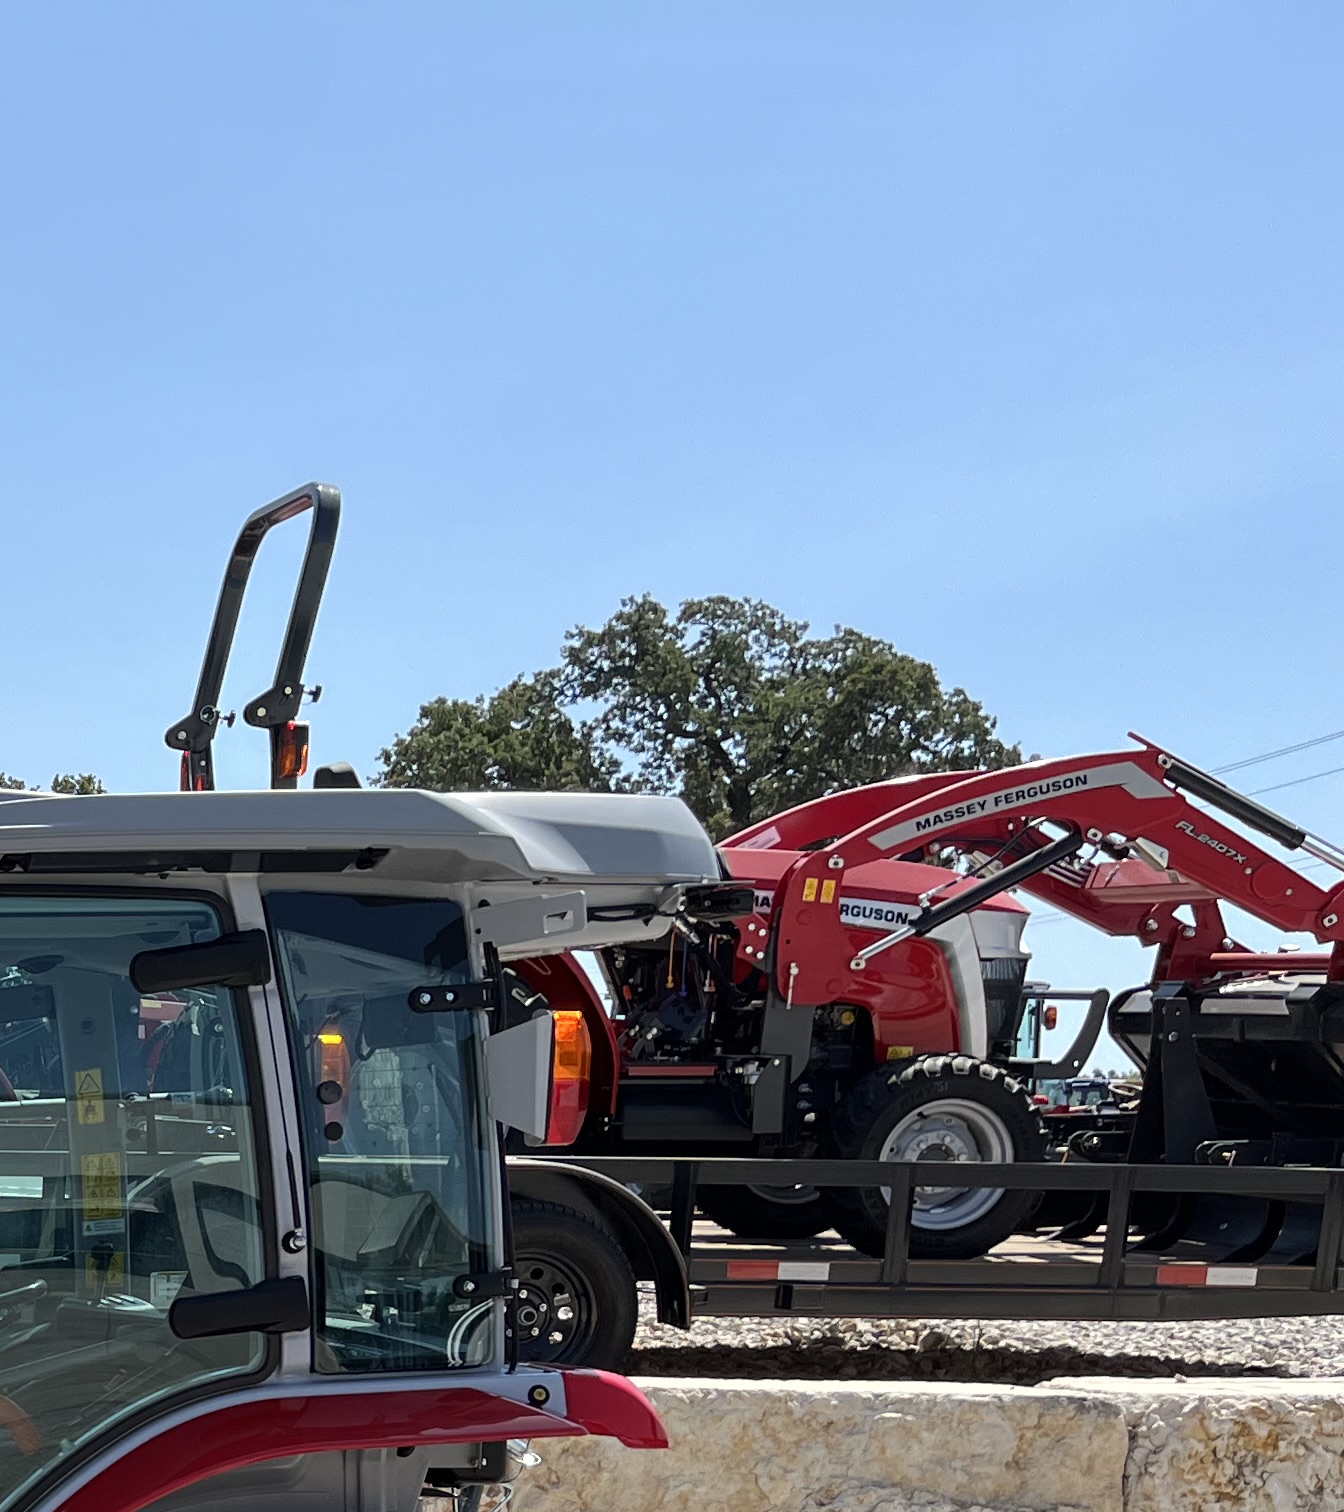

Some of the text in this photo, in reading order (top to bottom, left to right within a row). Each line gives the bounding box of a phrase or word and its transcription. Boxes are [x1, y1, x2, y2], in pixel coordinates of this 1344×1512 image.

[915, 774, 1088, 832] MASSEY FERGUSON
[839, 903, 909, 925] RGUSON
